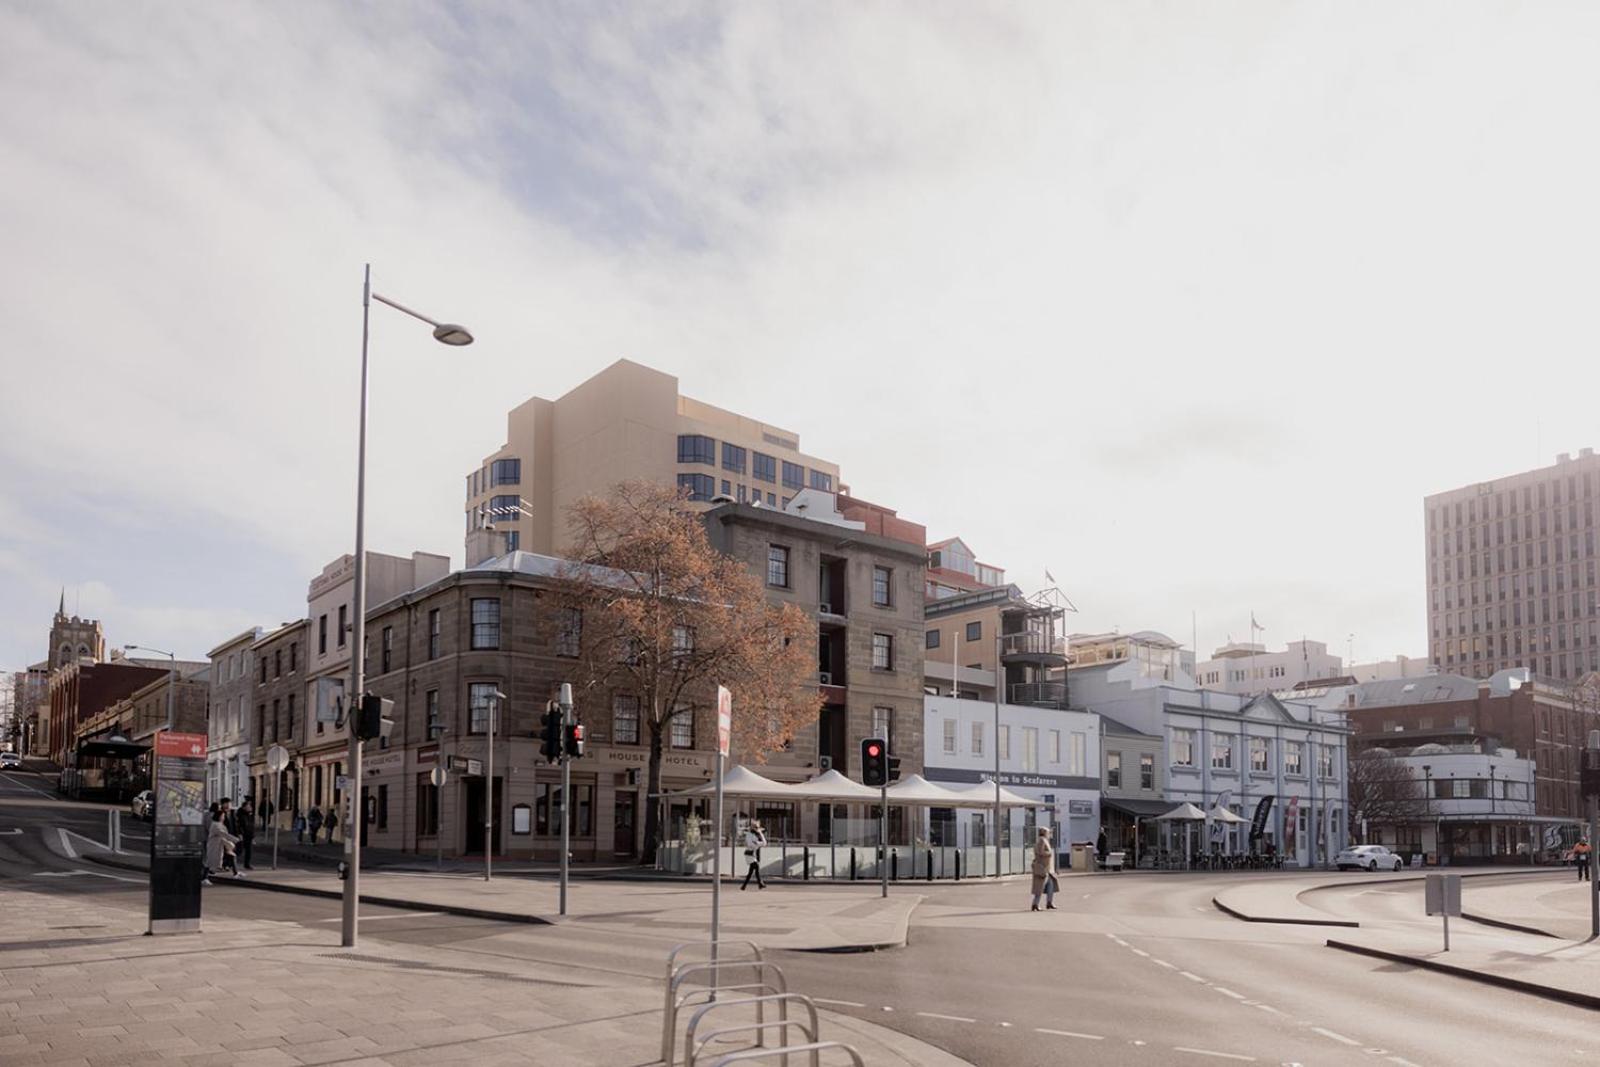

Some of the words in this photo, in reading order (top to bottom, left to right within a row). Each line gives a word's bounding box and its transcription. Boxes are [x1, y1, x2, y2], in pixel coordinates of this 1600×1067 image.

[609, 752, 646, 762] HOUSE
[665, 757, 700, 766] HOTEL
[980, 773, 1009, 783] Misson
[1011, 775, 1020, 784] to
[1022, 776, 1058, 786] Seafarers
